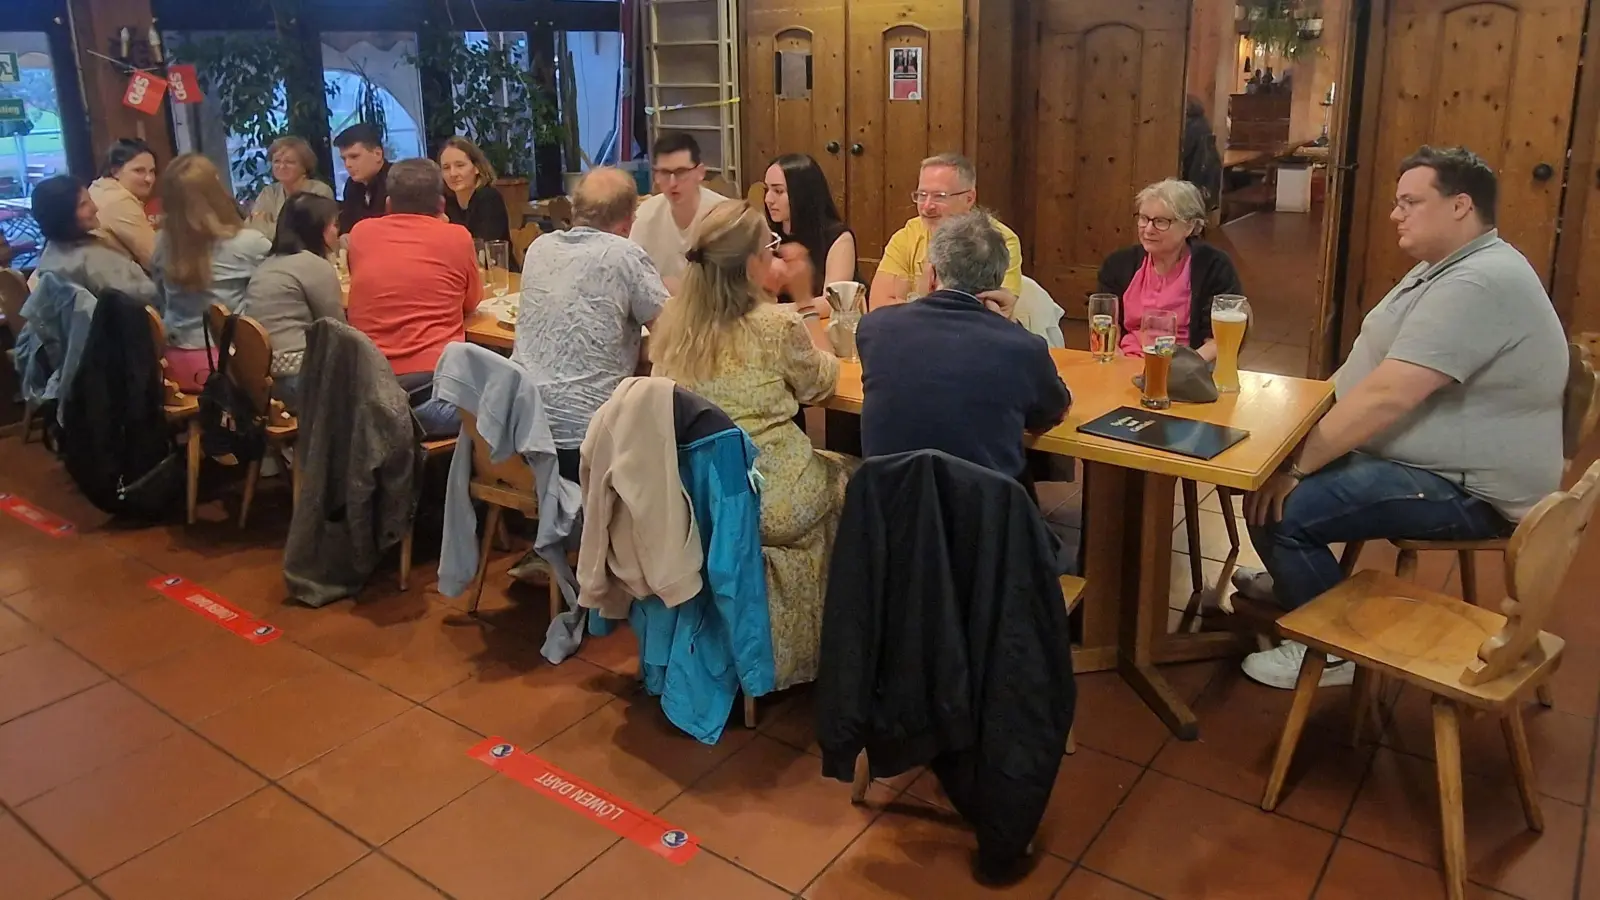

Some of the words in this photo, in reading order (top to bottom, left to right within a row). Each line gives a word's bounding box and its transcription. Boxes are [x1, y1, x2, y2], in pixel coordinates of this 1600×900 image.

[127, 75, 150, 105] SPD
[168, 72, 188, 101] SPD
[533, 771, 576, 796] DART
[568, 788, 624, 821] LÖWEN
